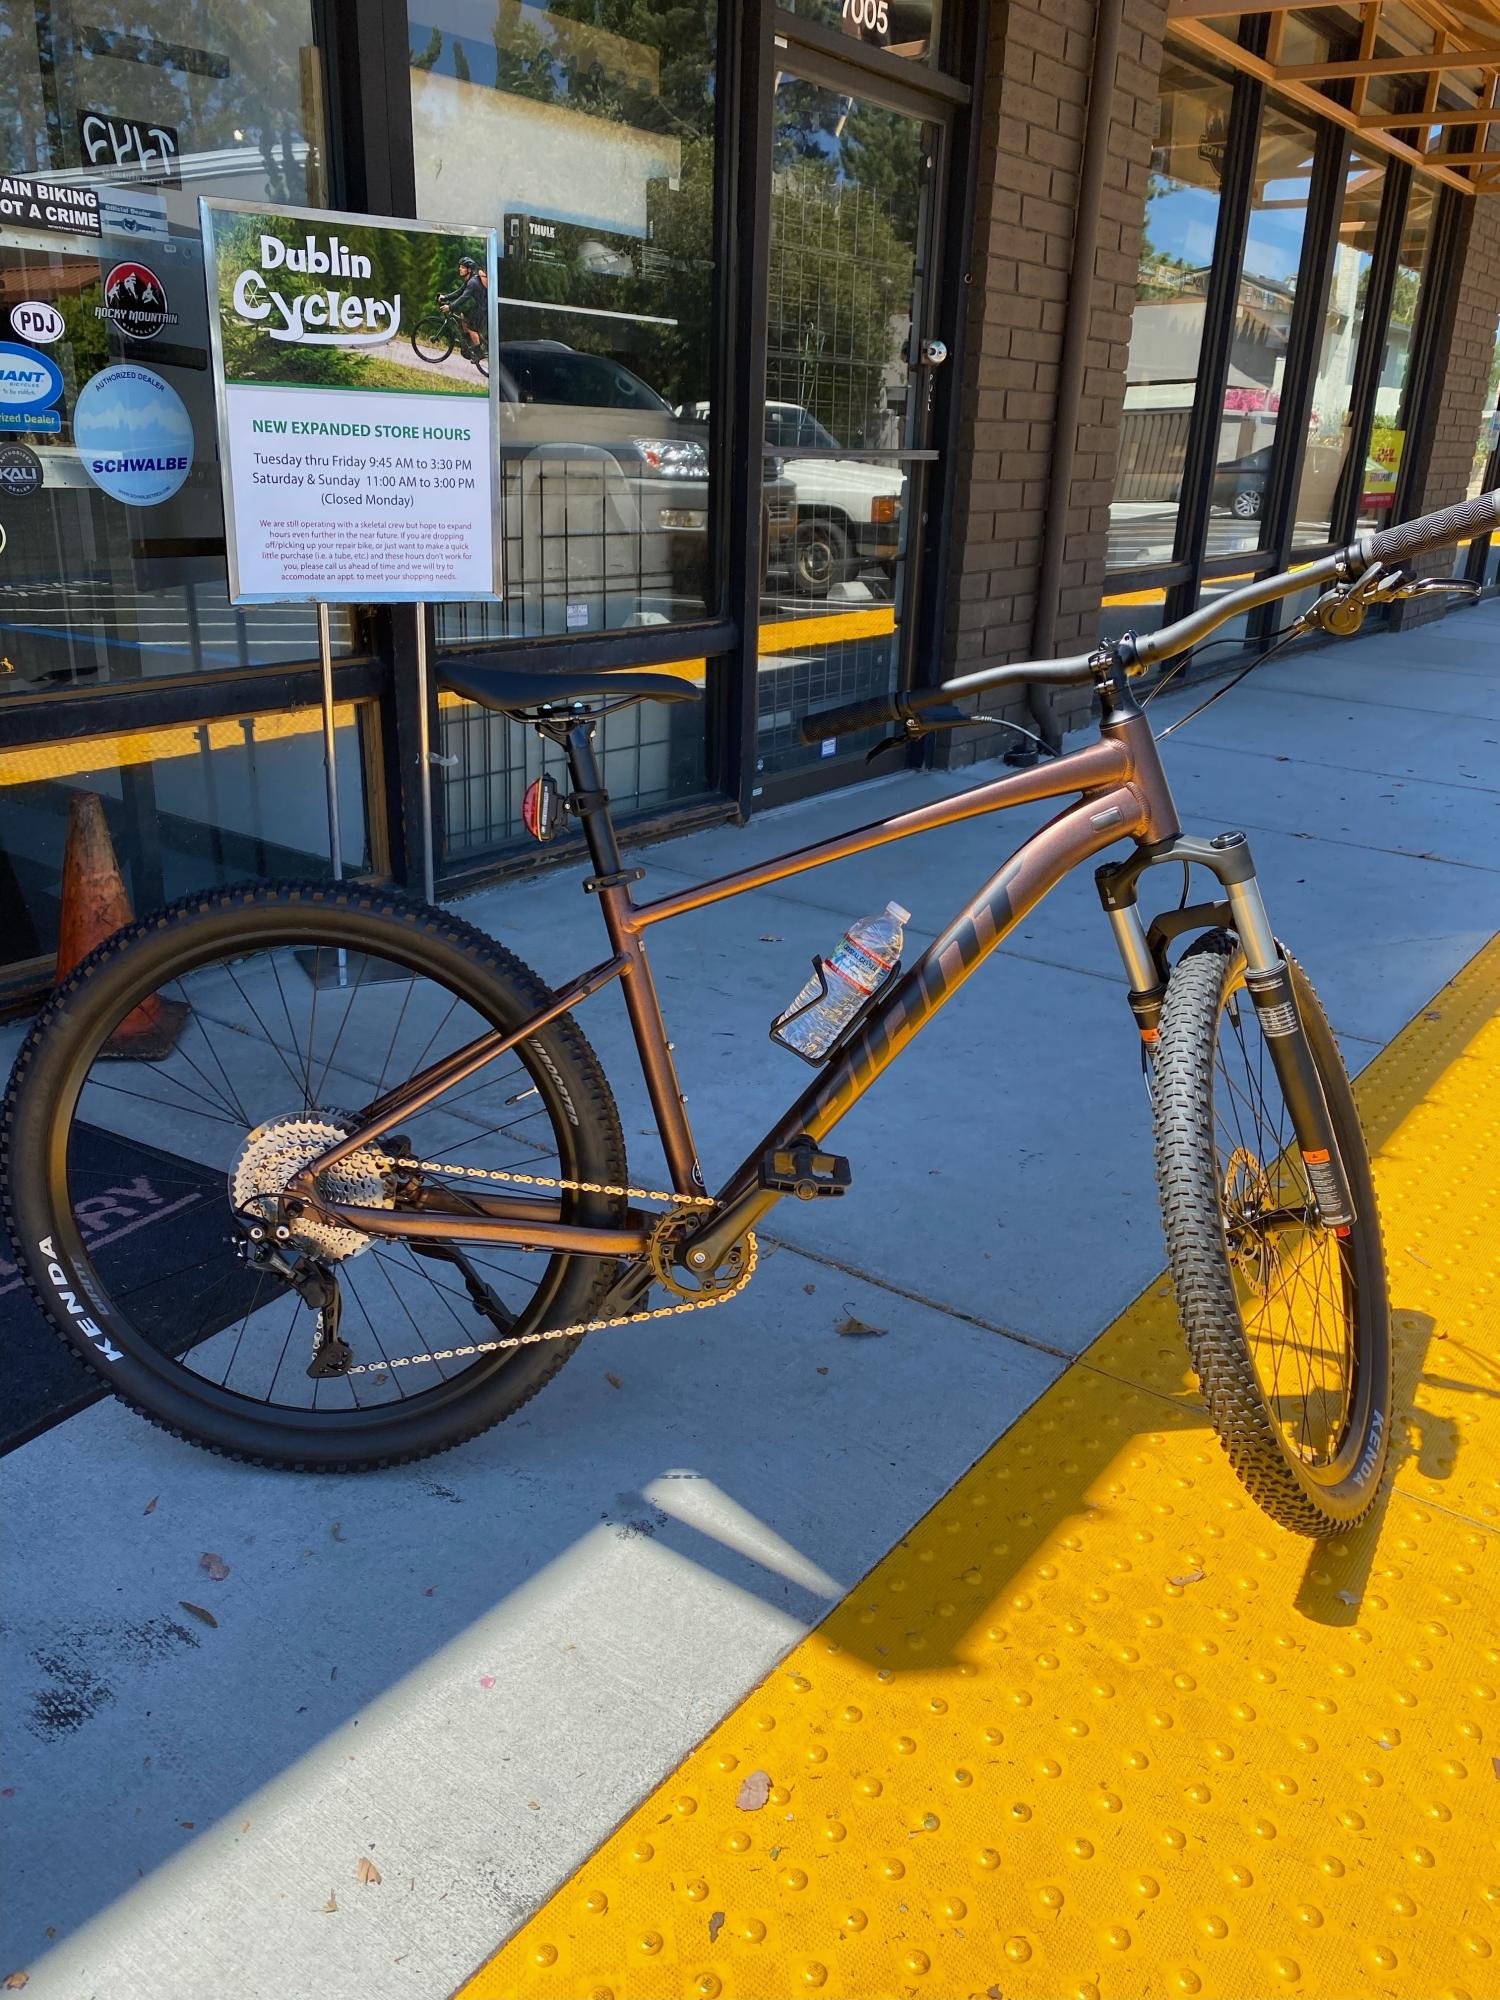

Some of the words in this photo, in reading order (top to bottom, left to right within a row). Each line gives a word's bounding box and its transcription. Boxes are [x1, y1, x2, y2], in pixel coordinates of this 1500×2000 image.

[842, 0, 889, 34] 7005
[0, 178, 32, 197] AIN
[37, 184, 97, 207] BIKING
[0, 199, 24, 216] OT
[29, 204, 42, 219] A
[46, 206, 99, 228] CRIME
[528, 223, 555, 239] THULE
[260, 234, 372, 279] Dublin
[94, 306, 127, 320] ROCKY
[128, 310, 178, 324] MOUNTAIN
[233, 269, 400, 345] Cyclery
[20, 311, 56, 333] PDJ
[95, 371, 136, 392] AUTHORIZED
[138, 373, 166, 392] DEALER
[24, 414, 55, 424] Dealer
[252, 419, 287, 434] NEW
[291, 420, 371, 437] EXPANDED
[374, 424, 419, 439] STORE
[422, 426, 471, 441] HOURS
[92, 457, 188, 473] SCHWALBE
[254, 452, 302, 468] Tuesday
[304, 453, 329, 466] thru
[332, 454, 366, 470] Friday
[368, 456, 392, 468] 9:45
[395, 457, 413, 468] AM
[416, 458, 427, 469] to
[430, 458, 452, 470] 3:30
[455, 459, 471, 470] PM
[0, 467, 37, 482] KALI
[252, 472, 304, 488] Saturday
[307, 474, 316, 485] &
[318, 474, 361, 489] Sunday
[366, 475, 397, 487] 11:00
[398, 476, 418, 488] AM
[419, 477, 431, 488] to
[432, 477, 457, 489] 3:00
[457, 477, 475, 489] PM
[8, 485, 31, 493] DEALER
[321, 493, 363, 507] (Closed
[365, 493, 413, 508] Monday)
[286, 519, 299, 527] still
[300, 521, 335, 529] operating
[336, 520, 353, 528] with
[360, 520, 386, 528] skeletal
[419, 521, 437, 532] hope
[446, 522, 471, 531] expand
[269, 531, 290, 539] hours
[310, 530, 336, 538] further
[345, 530, 357, 539] the
[432, 531, 464, 541] dropping
[317, 542, 333, 551] your
[335, 542, 356, 550] repair
[384, 542, 396, 550] just
[398, 542, 415, 550] want
[450, 542, 469, 551] quick
[261, 551, 278, 559] little
[279, 551, 313, 560] purchase
[404, 551, 424, 559] hours
[300, 561, 323, 571] please
[280, 572, 325, 580] accomodate
[402, 573, 433, 581] shopping
[38, 1235, 124, 1362] KENDA
[1352, 1408, 1385, 1488] KENDA
